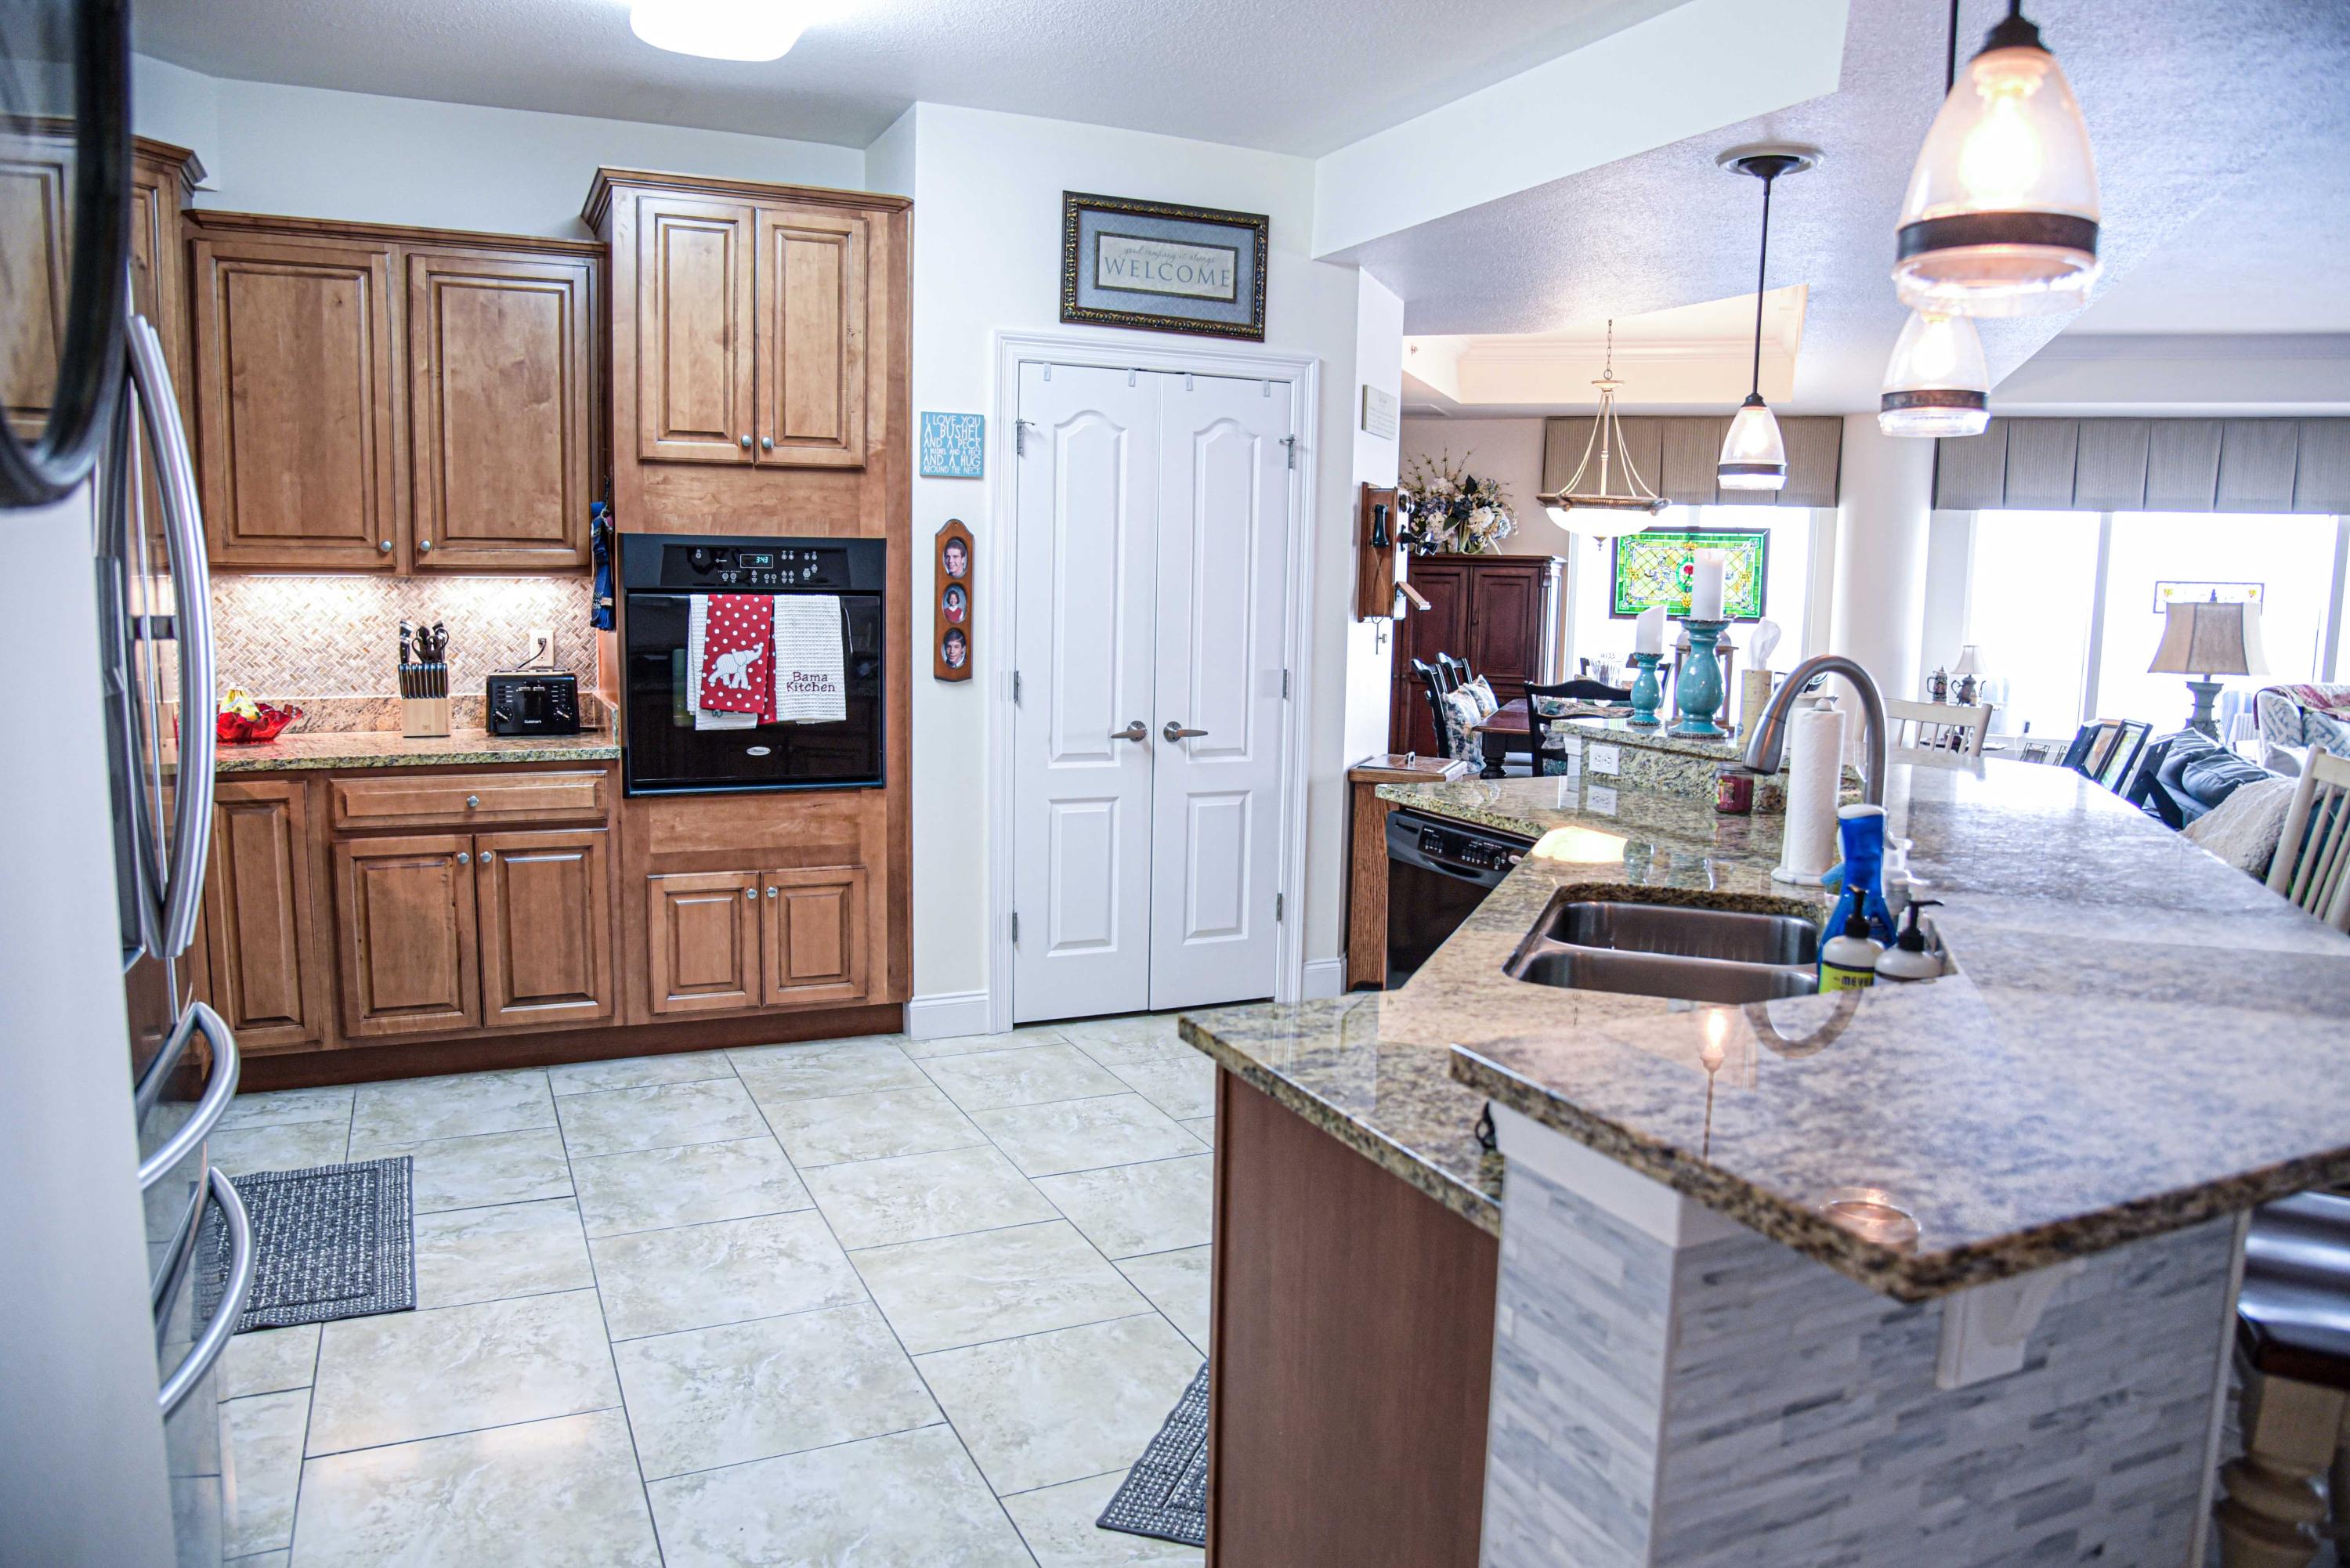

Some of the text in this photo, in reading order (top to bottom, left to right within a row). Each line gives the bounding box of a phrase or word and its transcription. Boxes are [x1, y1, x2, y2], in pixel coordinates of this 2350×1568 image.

[1120, 246, 1144, 258] good
[1145, 249, 1176, 263] company
[1189, 253, 1216, 266] always
[1104, 257, 1230, 287] WELCOME
[933, 415, 956, 425] LOVE
[961, 416, 981, 427] YOU
[924, 423, 978, 439] A BUSHEL
[924, 437, 981, 450] AND A PECK
[924, 455, 981, 467] AND A HUG
[793, 671, 828, 681] Bama
[786, 682, 835, 692] Kitchen
